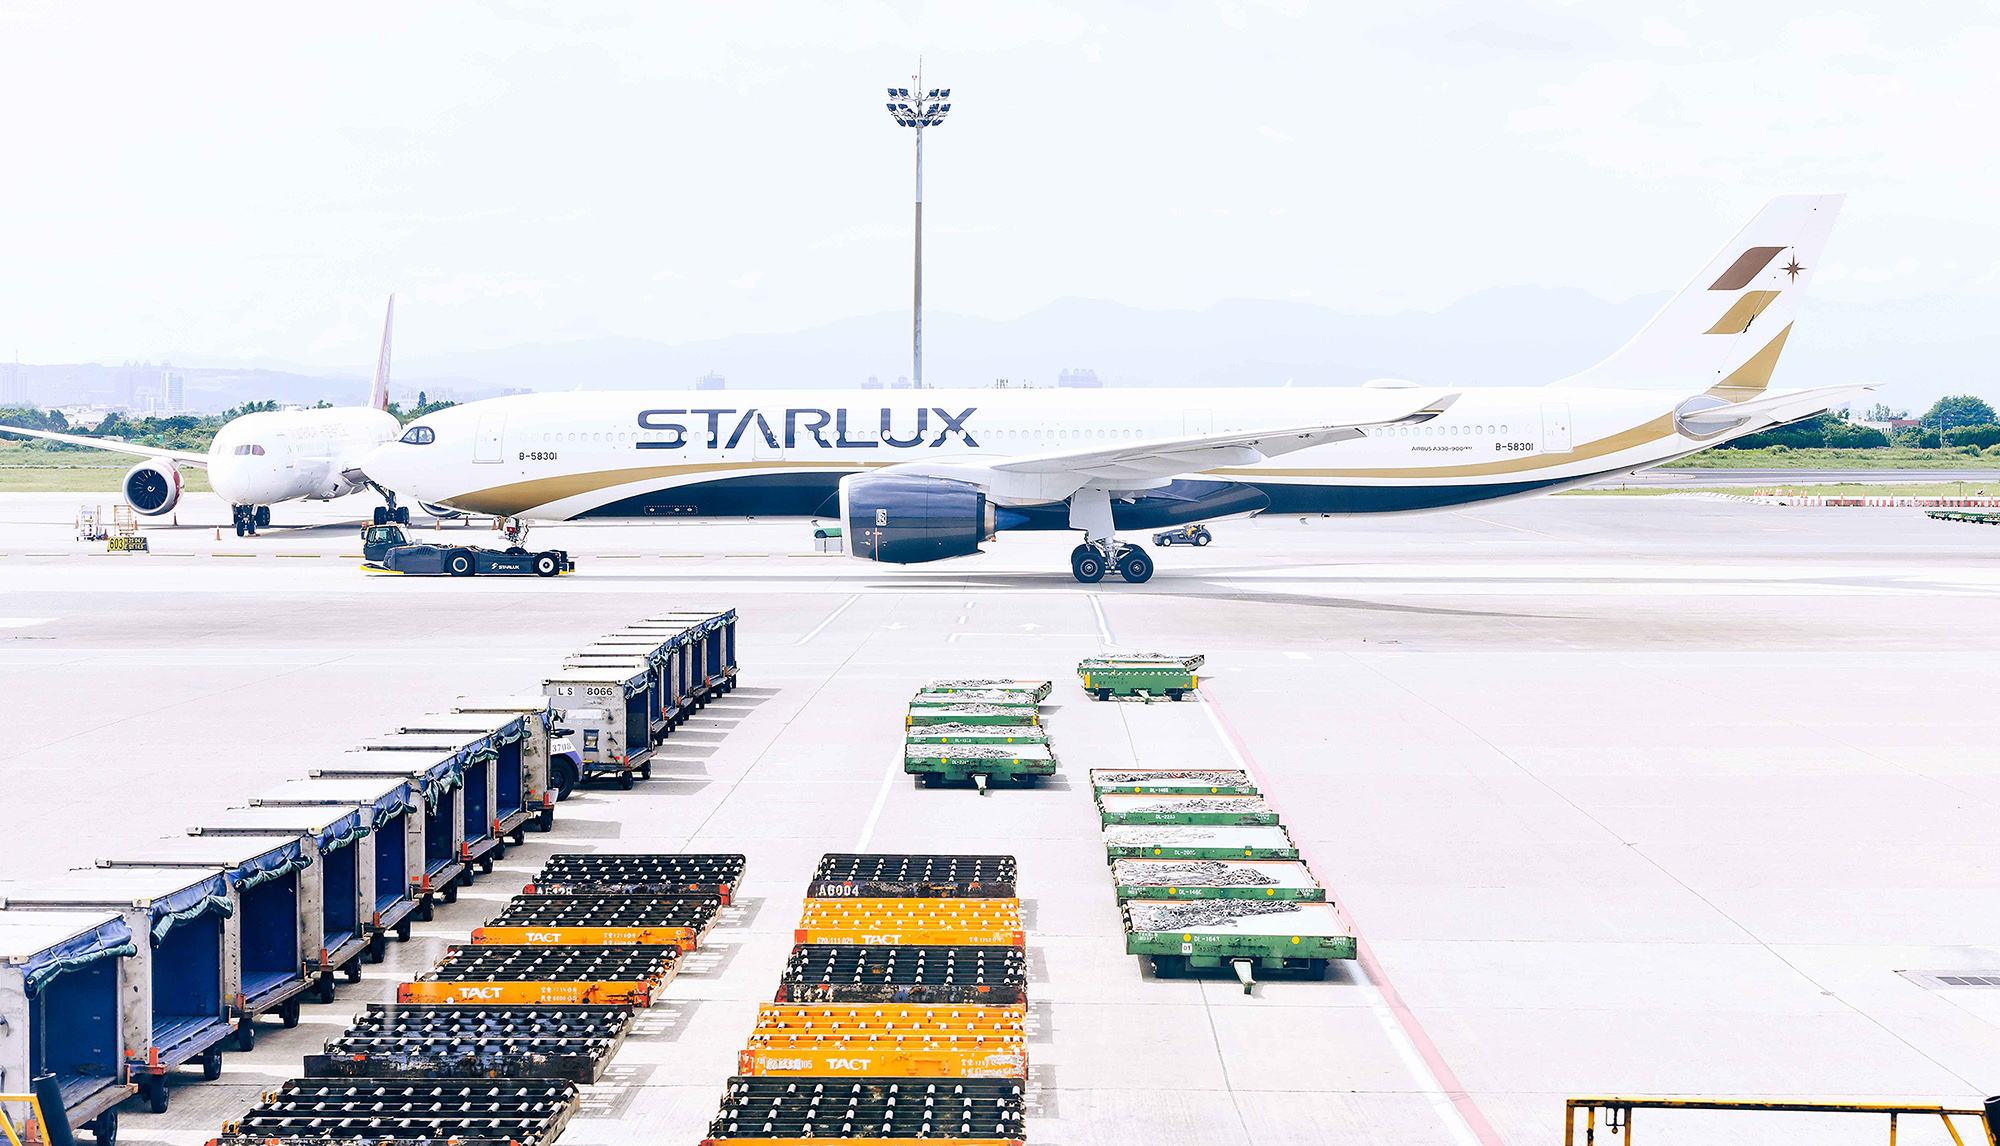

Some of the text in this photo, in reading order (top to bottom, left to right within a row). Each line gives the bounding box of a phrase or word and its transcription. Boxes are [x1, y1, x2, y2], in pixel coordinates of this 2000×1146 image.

[636, 408, 980, 448] STARLUX
[109, 538, 123, 550] 603
[587, 687, 613, 696] 8066
[525, 932, 562, 942] TACT
[861, 934, 902, 944] TACT
[458, 987, 503, 999] TACT
[825, 1058, 872, 1071] TACT
